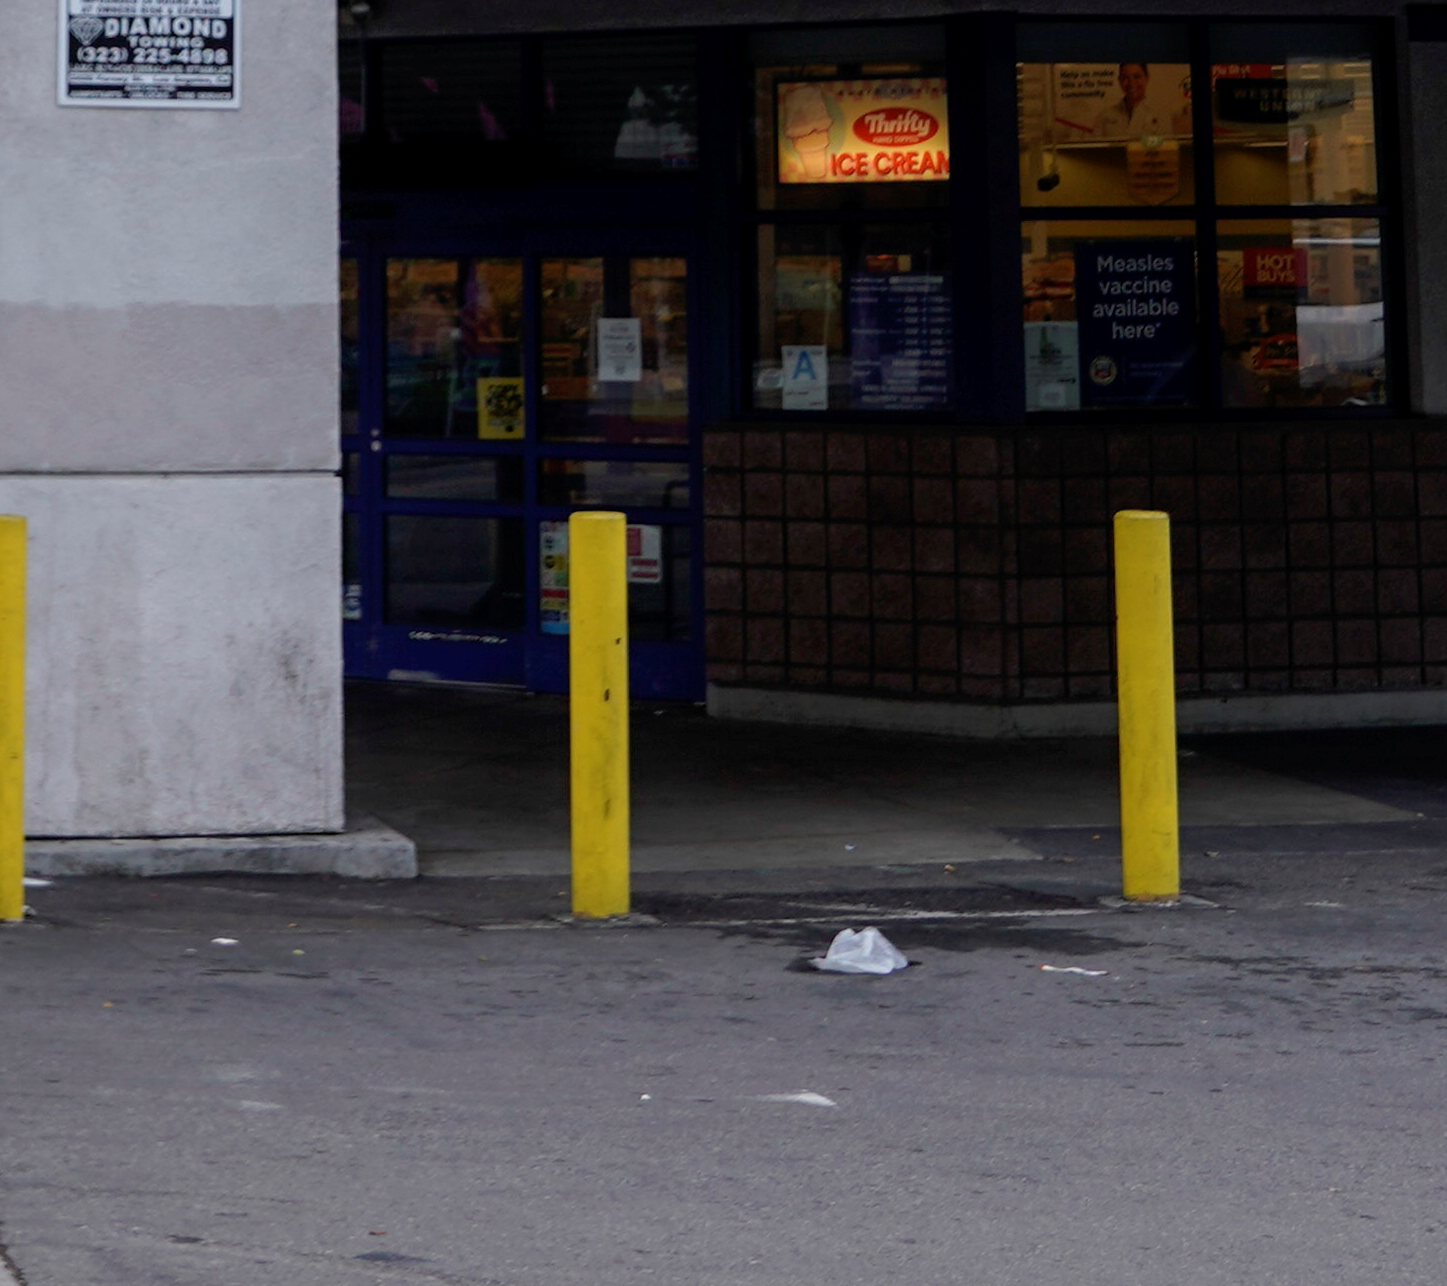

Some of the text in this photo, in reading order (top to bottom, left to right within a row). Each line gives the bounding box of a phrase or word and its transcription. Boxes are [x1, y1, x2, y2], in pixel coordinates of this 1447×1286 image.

[104, 17, 227, 39] DIAMOND
[127, 36, 205, 48] TOWING
[76, 46, 129, 63] (323)
[1234, 87, 1327, 101] WESTERN
[864, 109, 932, 137] Thrifty
[831, 152, 869, 176] ICE
[1096, 253, 1175, 273] Measles
[1256, 254, 1297, 269] HOT
[1257, 269, 1297, 283] BUYS
[1098, 276, 1174, 297] vaccine
[1091, 297, 1180, 318] available
[791, 349, 816, 380] A
